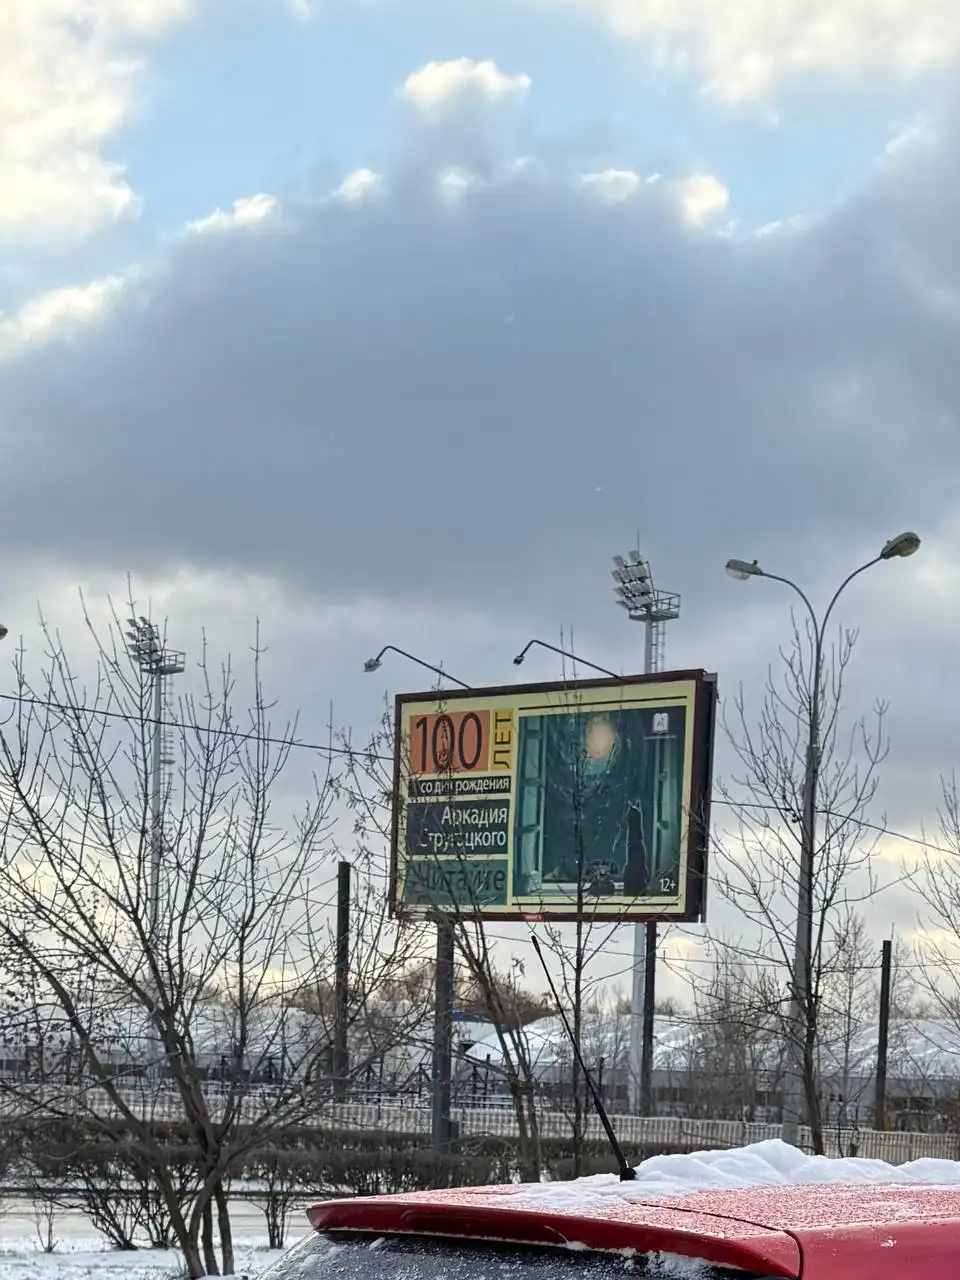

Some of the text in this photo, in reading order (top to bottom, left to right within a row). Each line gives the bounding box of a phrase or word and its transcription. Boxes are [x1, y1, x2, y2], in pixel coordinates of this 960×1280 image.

[415, 712, 483, 771] 100
[494, 711, 513, 768] ЛЕТ
[421, 781, 432, 793] со
[455, 777, 509, 794] рождения
[441, 805, 508, 828] Аркадия
[660, 878, 677, 891] 12+
